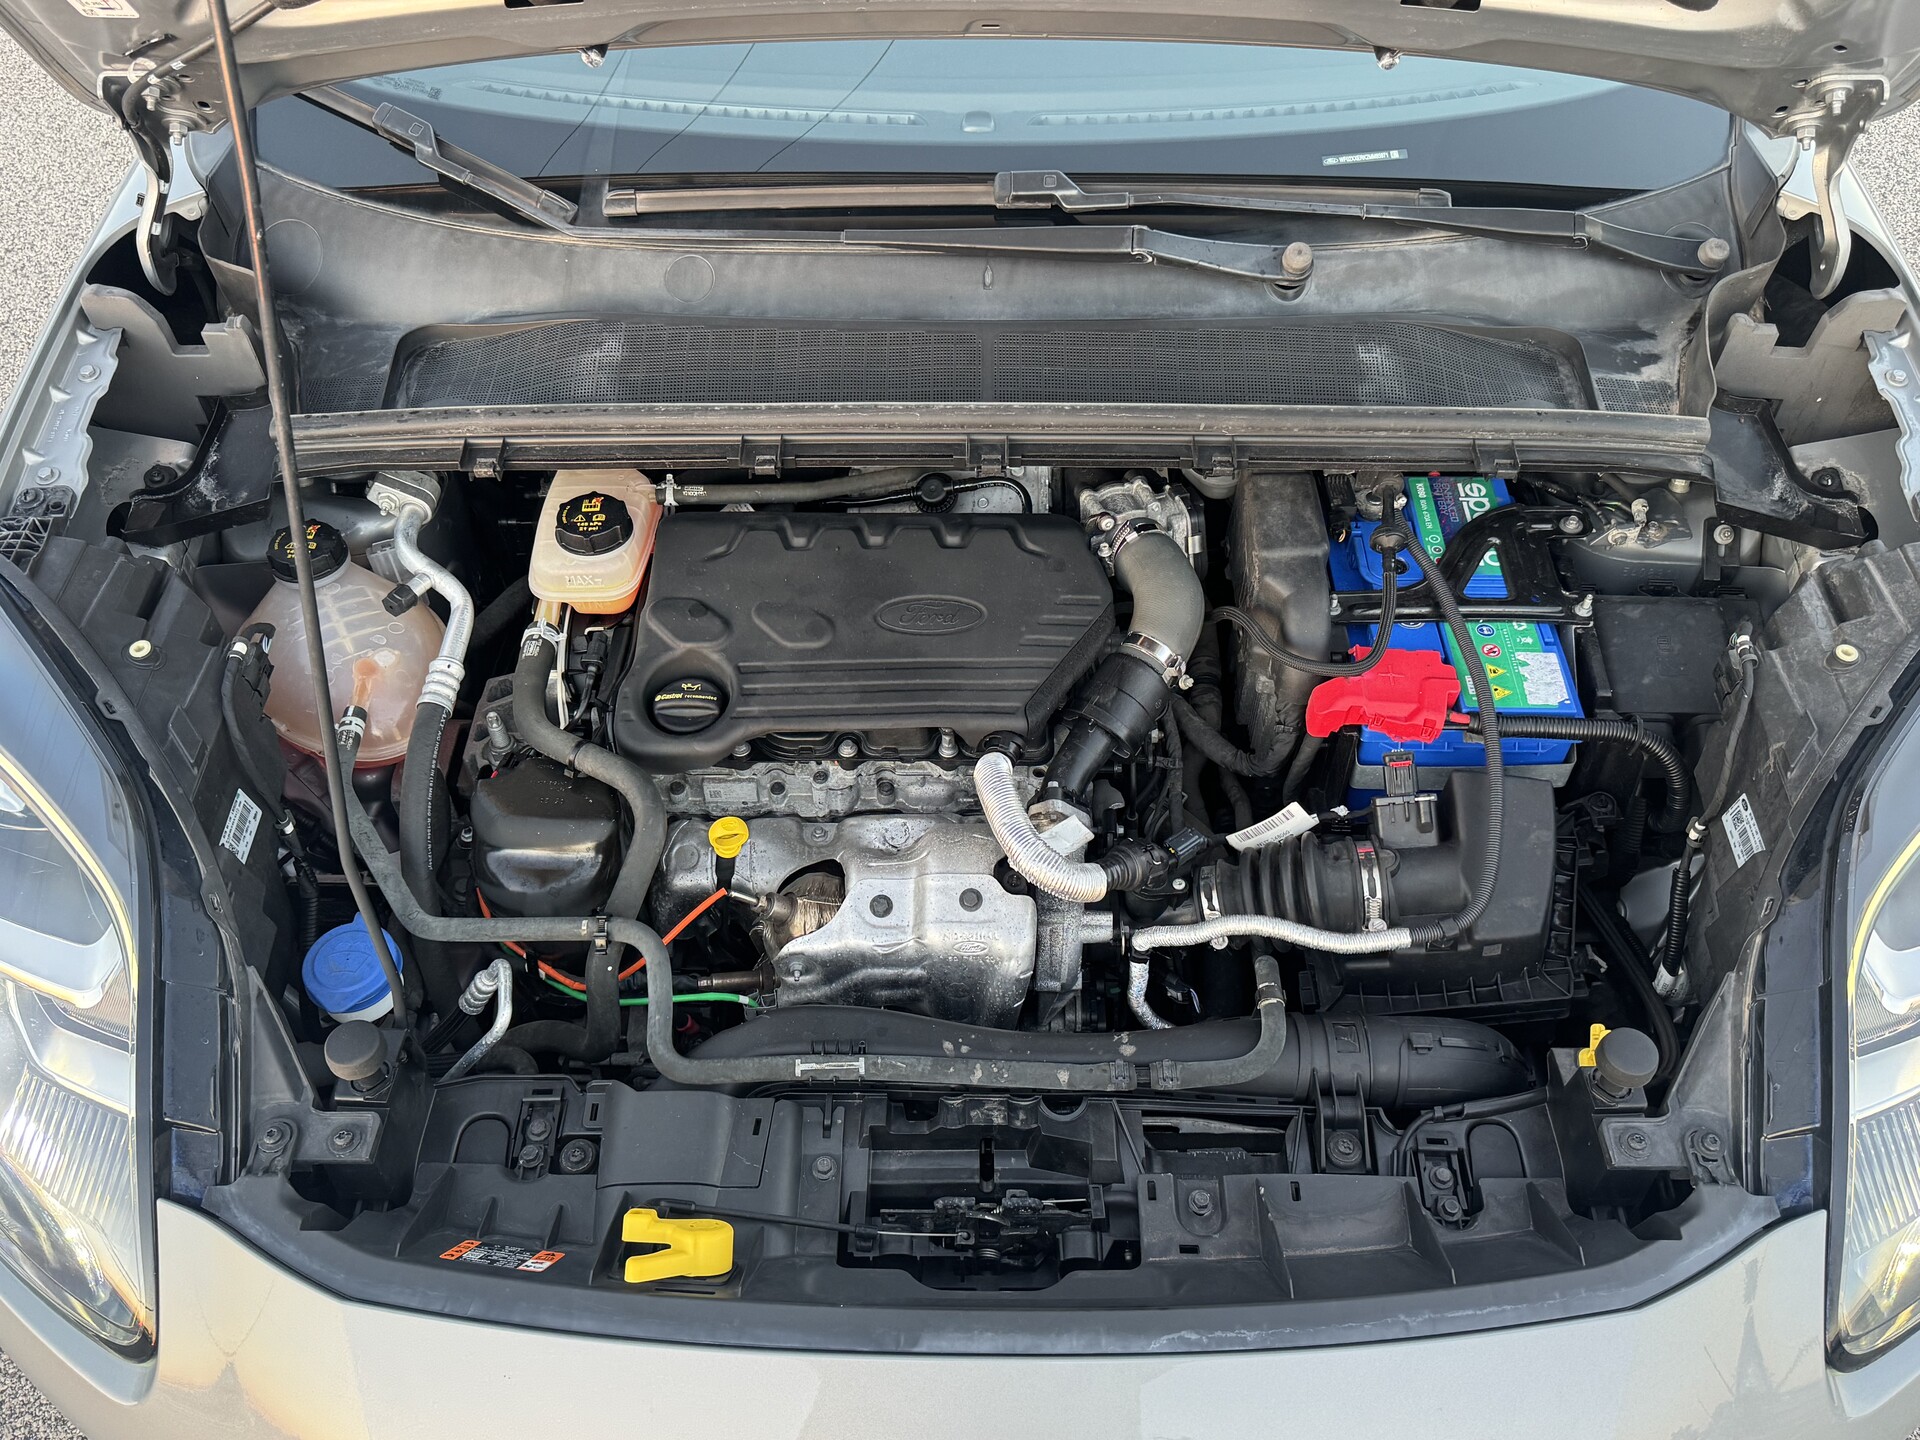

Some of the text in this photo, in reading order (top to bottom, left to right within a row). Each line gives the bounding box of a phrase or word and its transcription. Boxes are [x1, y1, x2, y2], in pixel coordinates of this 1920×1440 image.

[1433, 482, 1449, 515] BATTERY
[1441, 482, 1459, 523] ENHANCED
[564, 575, 594, 586] MAX
[898, 602, 960, 626] Ford
[660, 692, 684, 700] Castrol
